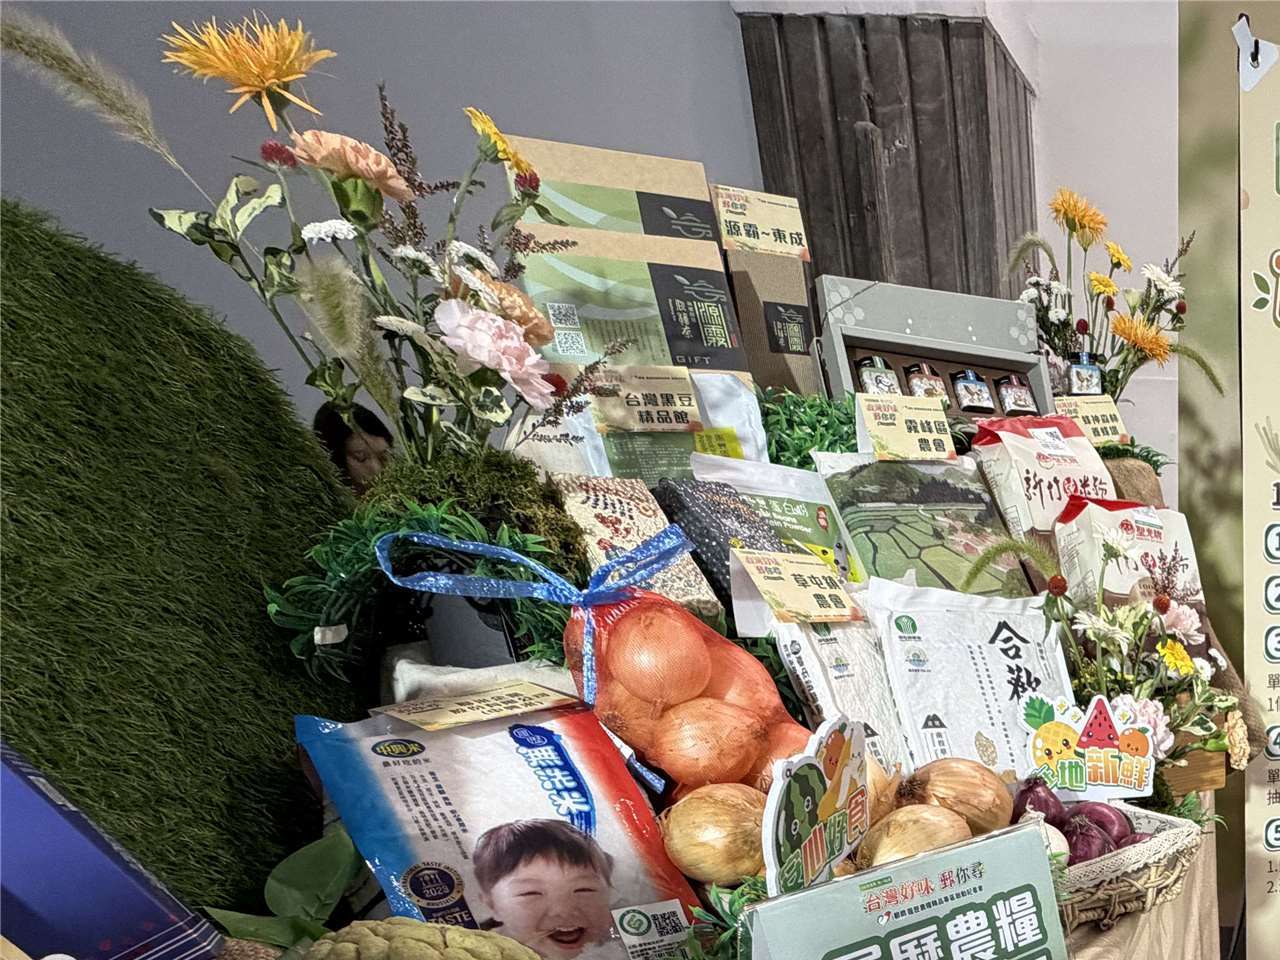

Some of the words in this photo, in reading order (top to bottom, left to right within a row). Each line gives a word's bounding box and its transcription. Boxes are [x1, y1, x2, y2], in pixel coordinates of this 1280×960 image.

[676, 355, 711, 364] GIFT
[625, 393, 695, 408] 台灣黑豆
[423, 885, 450, 898] 2023
[865, 878, 935, 913] 台灣好味
[937, 861, 986, 890] 郵你尋
